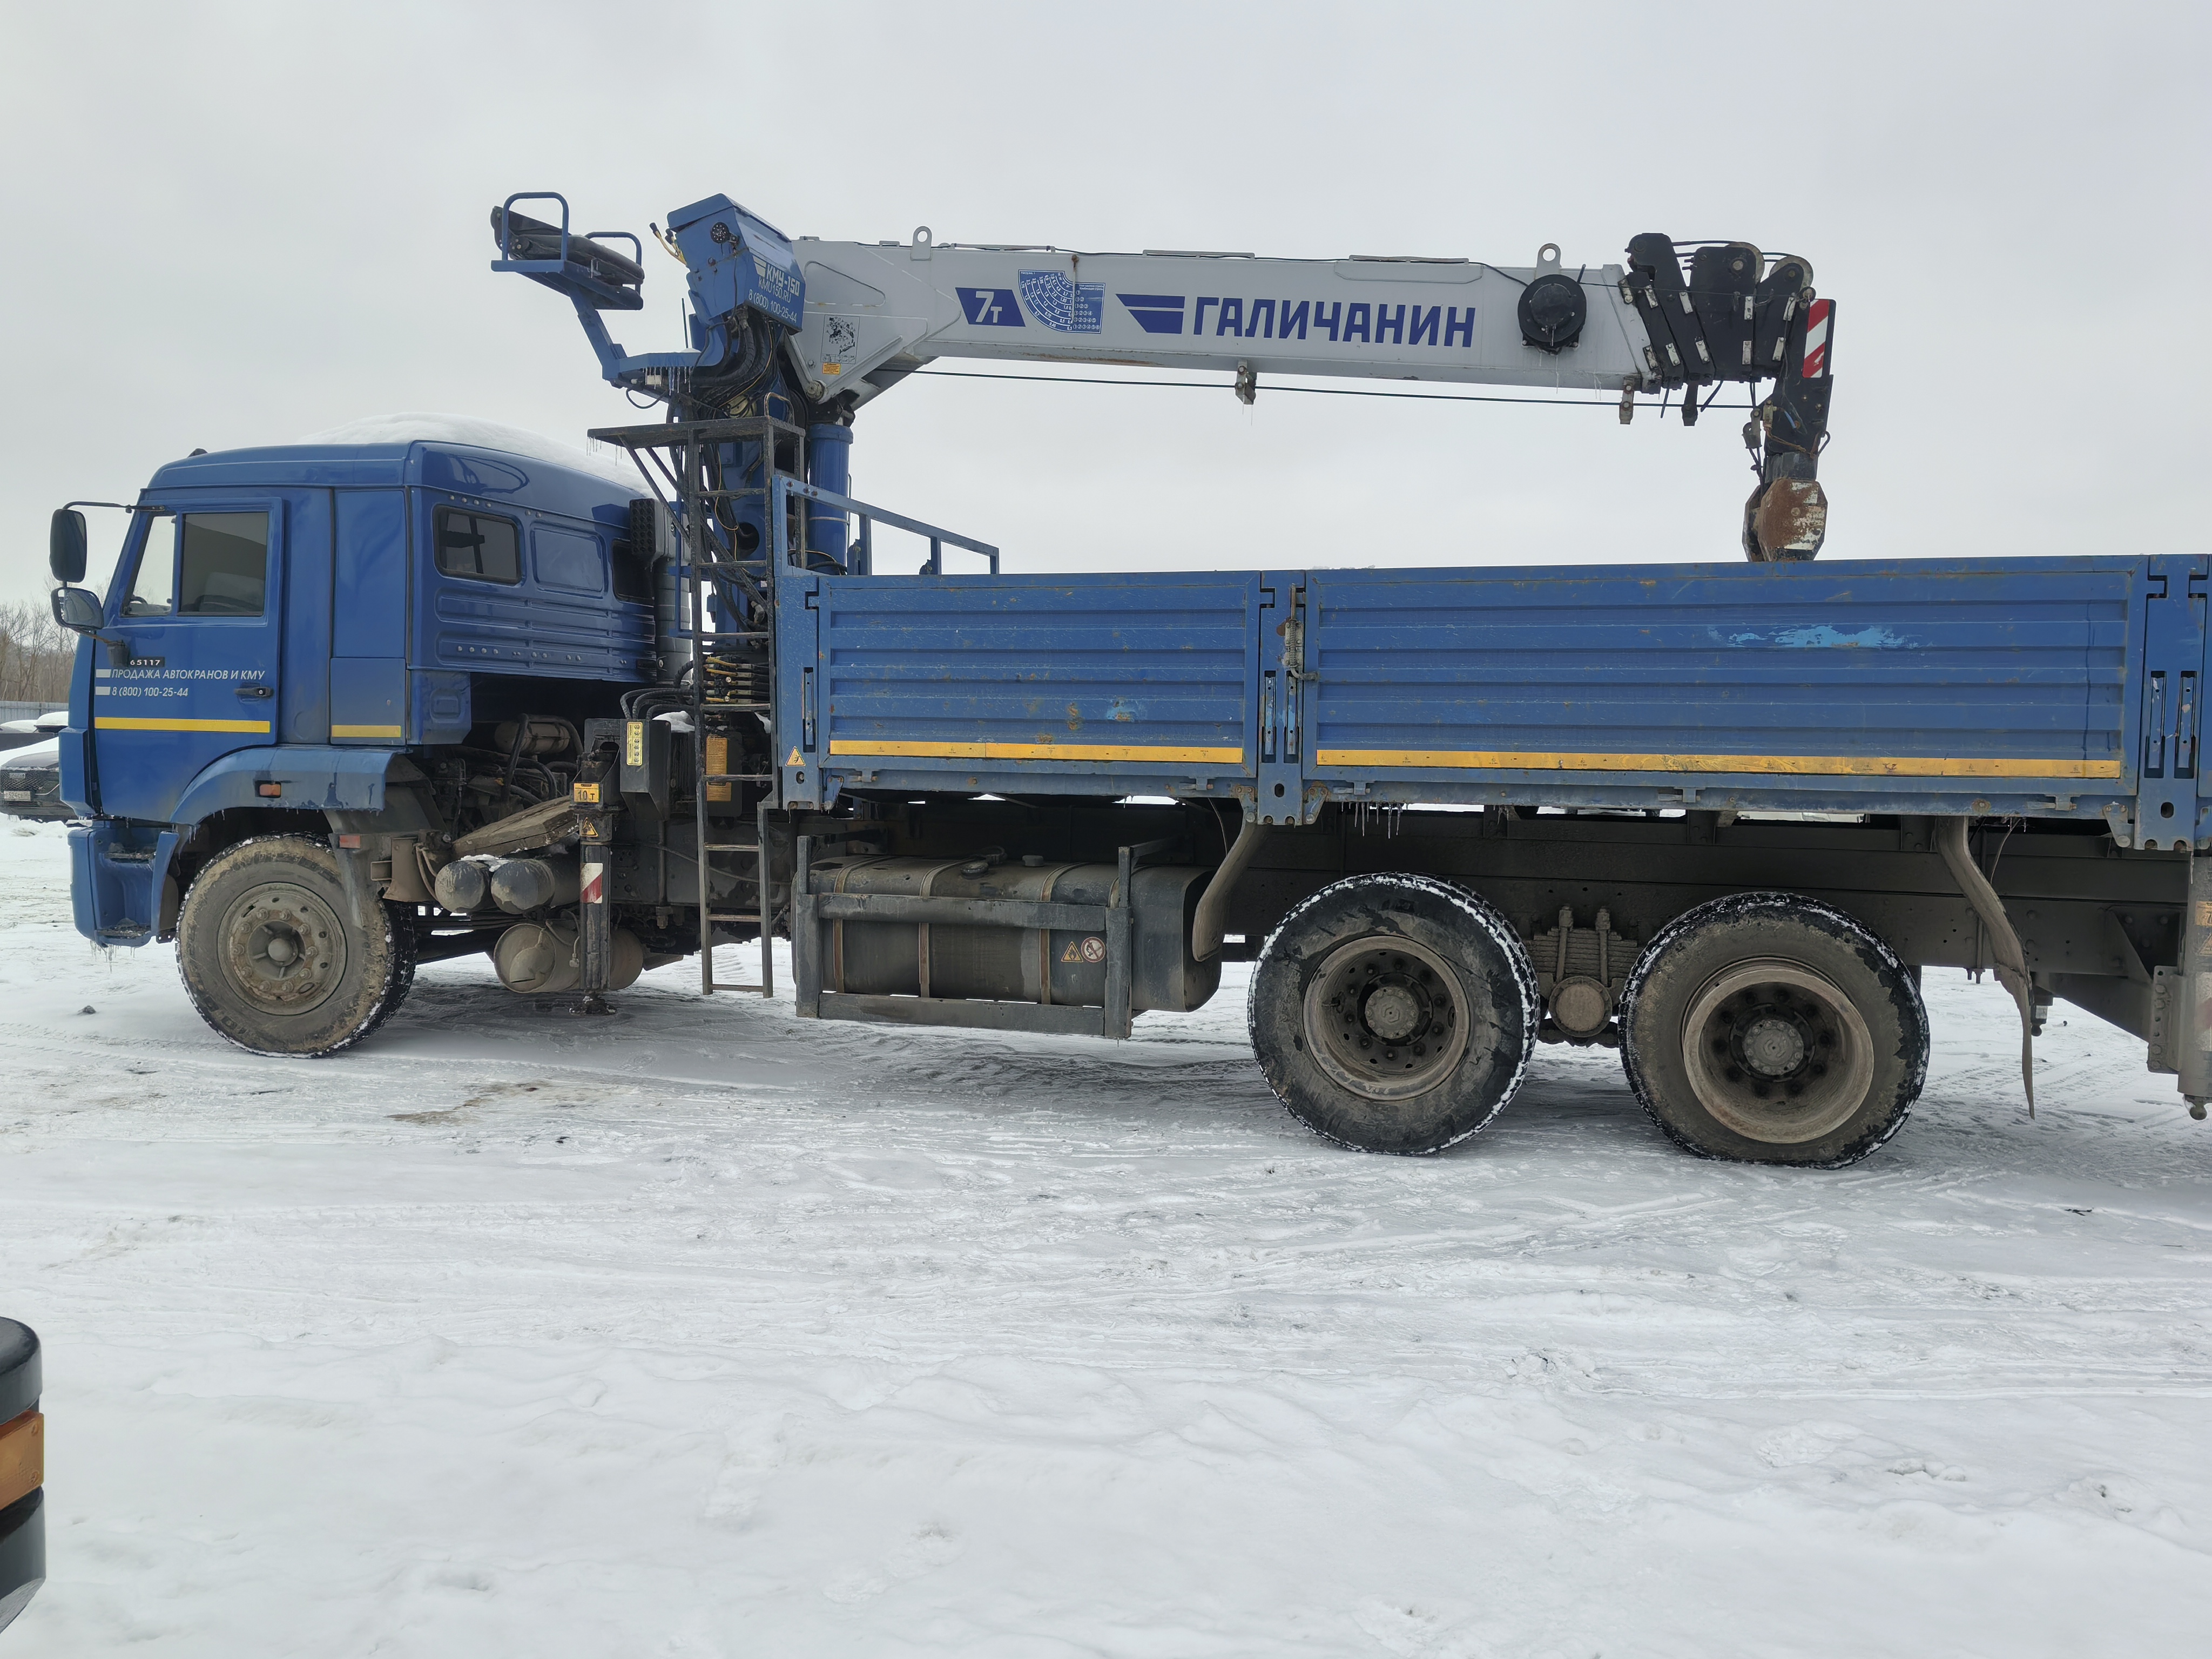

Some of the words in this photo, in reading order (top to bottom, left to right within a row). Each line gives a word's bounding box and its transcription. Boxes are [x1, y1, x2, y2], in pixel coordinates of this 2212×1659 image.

[758, 276, 792, 303] KMU150.RU
[748, 289, 753, 300] 8
[753, 292, 769, 309] (800)
[771, 300, 797, 323] 100-25-44
[1193, 296, 1476, 348] ГАЛИЧАНИН
[111, 669, 160, 680] ПРОДАЖА
[163, 669, 228, 680] АВТОКРАНОВ
[231, 670, 239, 680] И
[240, 670, 265, 680] КМУ
[112, 686, 117, 696] 8
[119, 687, 141, 697] (800)
[144, 687, 188, 697] 100-25-44
